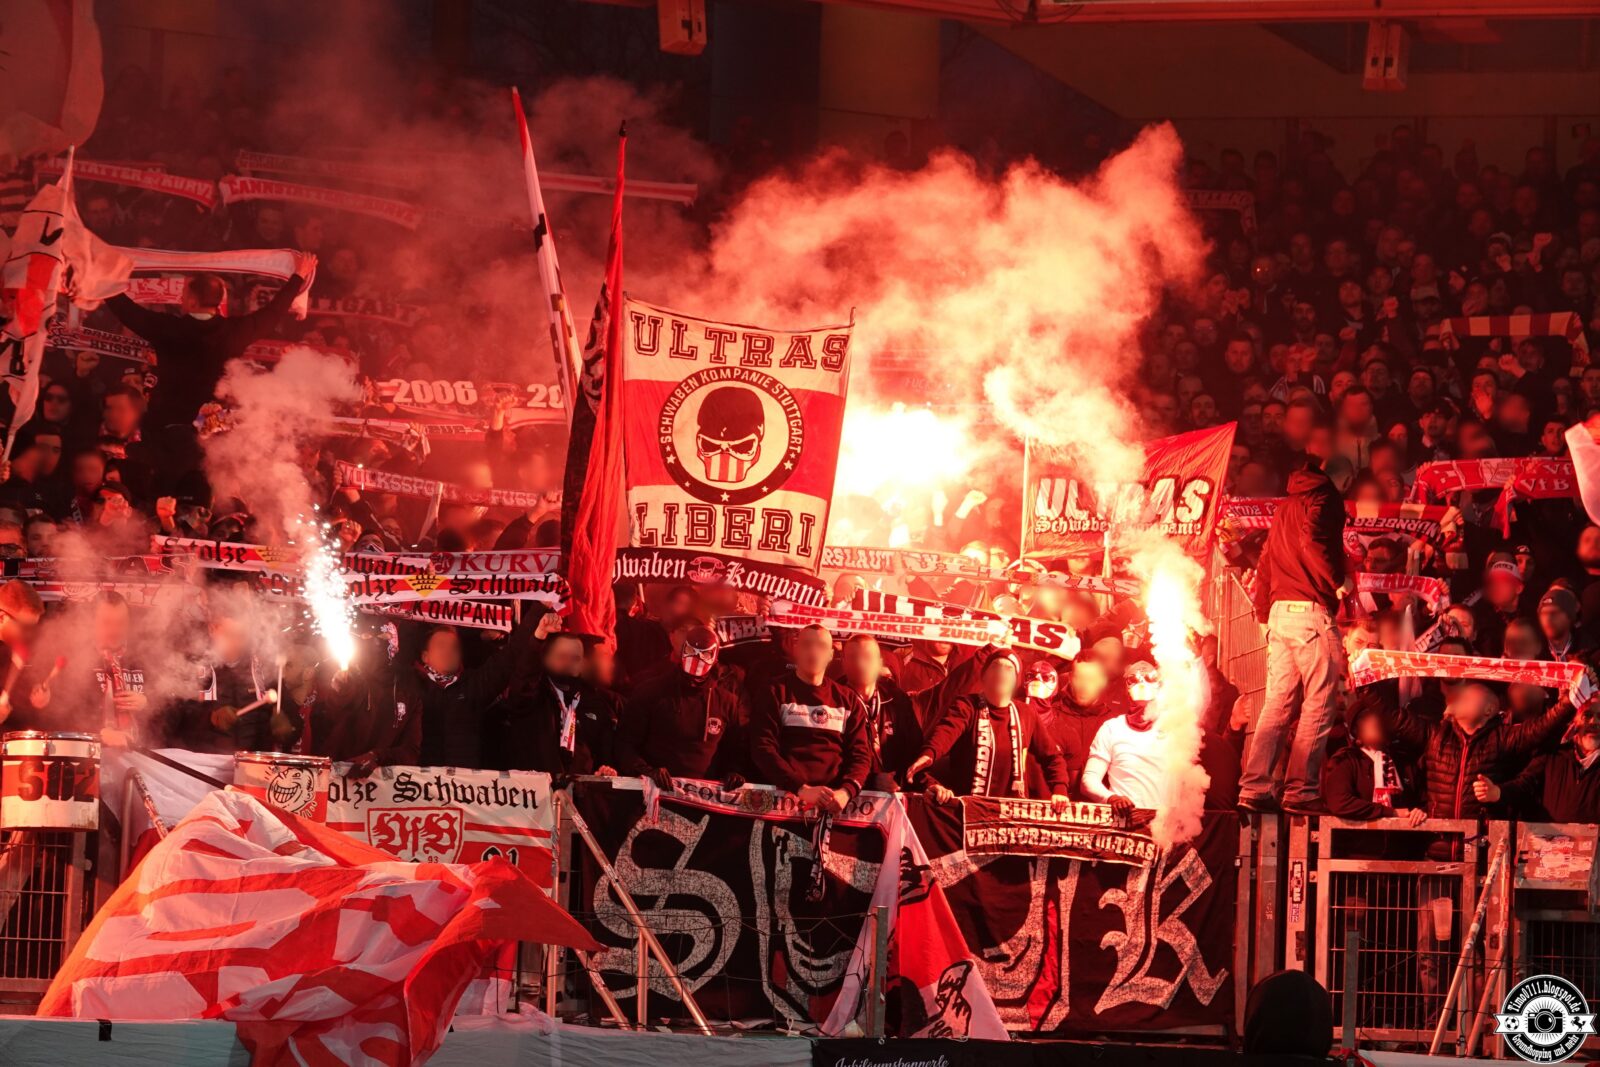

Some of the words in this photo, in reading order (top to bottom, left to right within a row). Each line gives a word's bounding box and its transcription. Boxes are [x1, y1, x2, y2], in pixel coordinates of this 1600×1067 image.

[630, 311, 850, 373] ULTRAS
[392, 378, 479, 406] 2006
[660, 376, 700, 444] SCHWABEN
[700, 367, 773, 388] KOMPANIE
[771, 382, 803, 454] STUTTGART
[633, 502, 816, 557] LIBERI
[1353, 517, 1439, 538] NÜRNBERG
[458, 553, 561, 574] KURV
[392, 772, 539, 810] Schwaben
